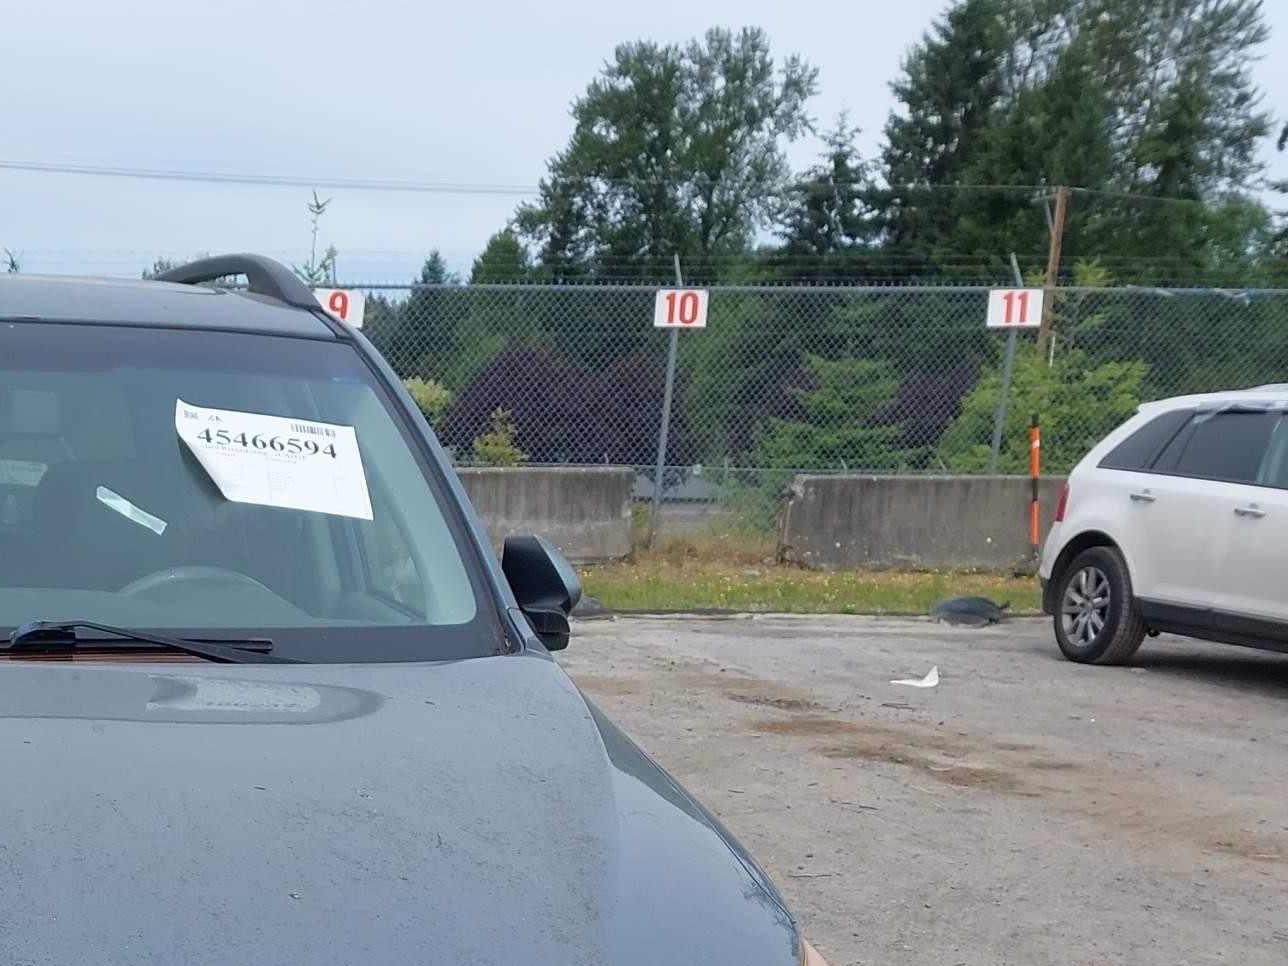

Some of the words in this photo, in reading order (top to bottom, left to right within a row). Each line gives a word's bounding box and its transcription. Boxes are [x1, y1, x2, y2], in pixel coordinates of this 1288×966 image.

[328, 291, 350, 319] 9
[666, 292, 701, 325] 10
[1003, 291, 1029, 322] 11
[197, 427, 337, 458] 45466594
